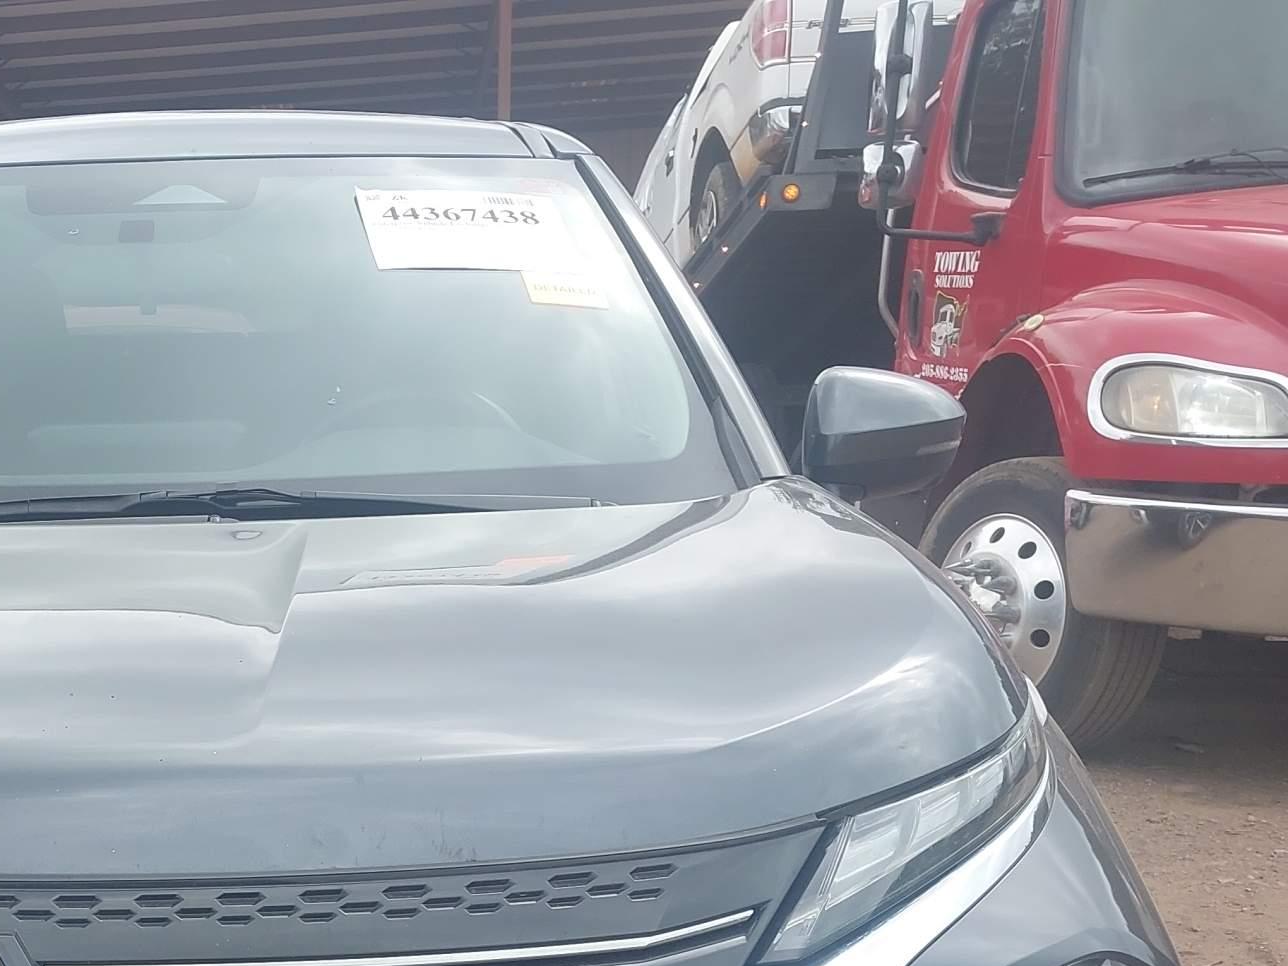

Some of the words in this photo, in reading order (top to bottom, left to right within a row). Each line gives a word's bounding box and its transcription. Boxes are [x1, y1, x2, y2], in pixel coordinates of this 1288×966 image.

[382, 206, 539, 225] 44367438
[933, 250, 980, 272] TOWING
[934, 274, 974, 289] SOLUTIONS
